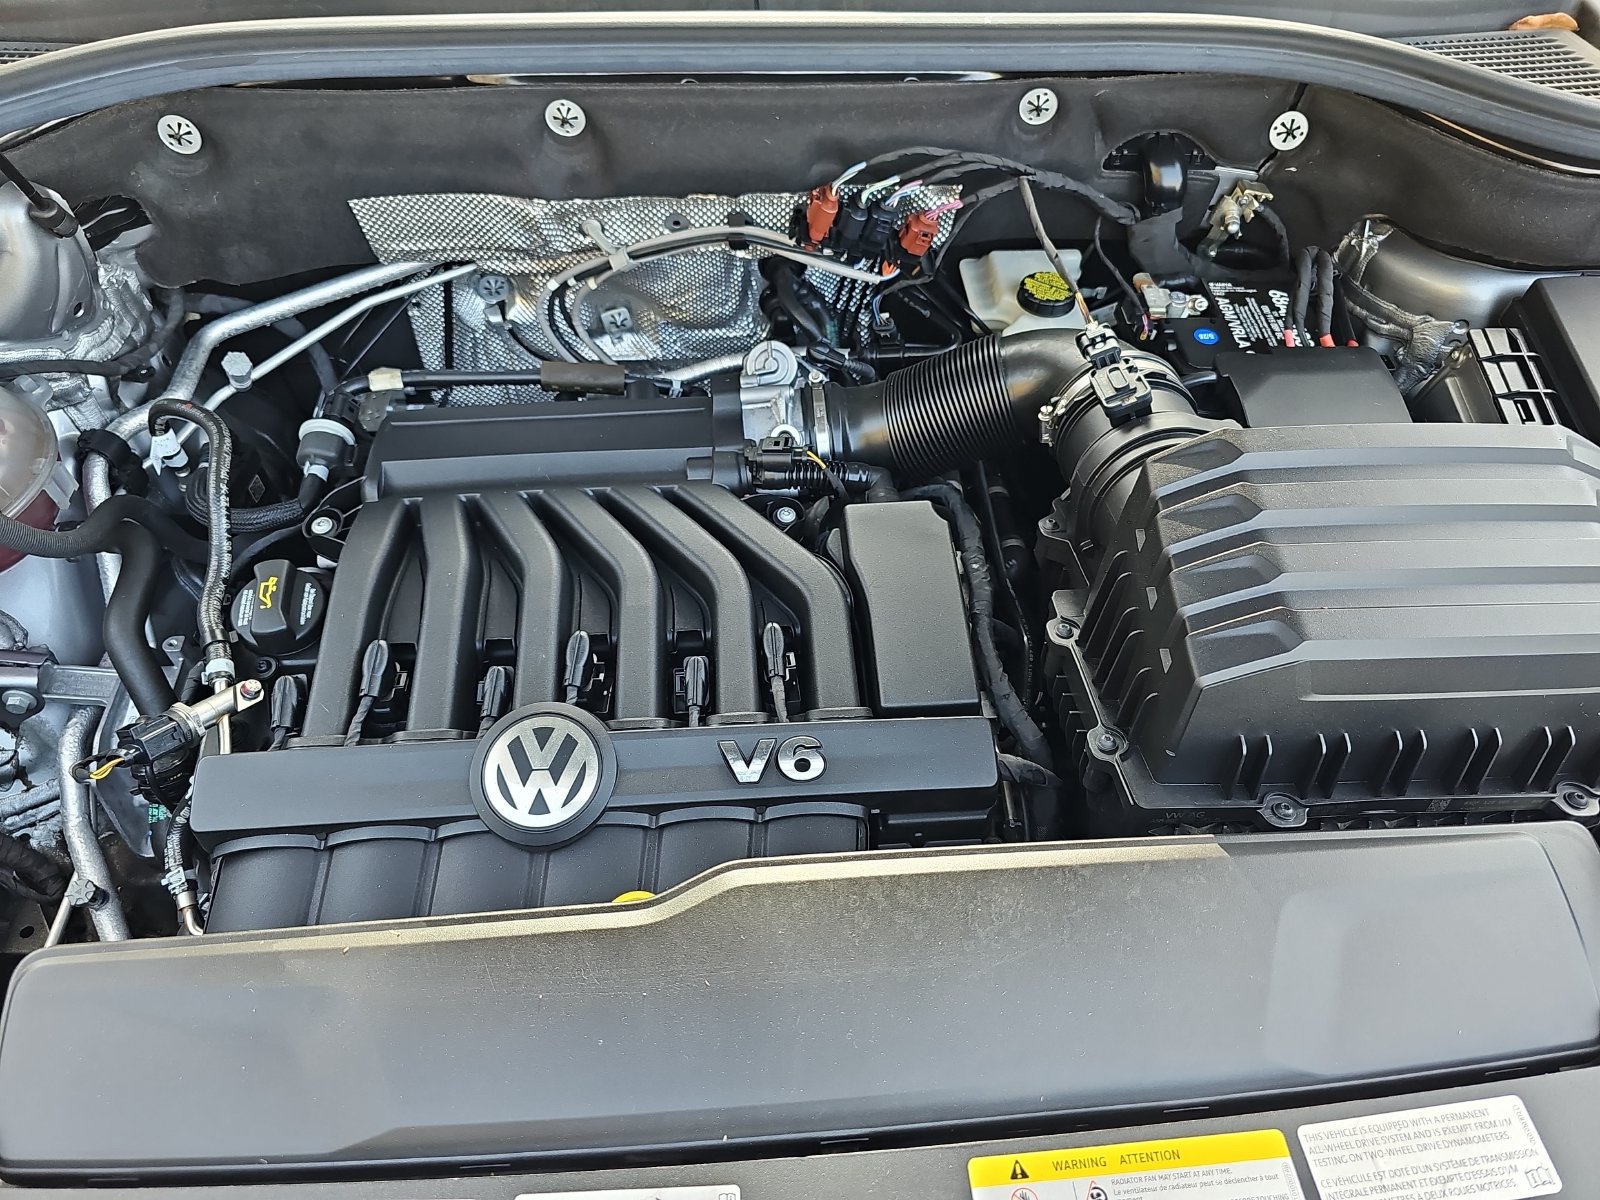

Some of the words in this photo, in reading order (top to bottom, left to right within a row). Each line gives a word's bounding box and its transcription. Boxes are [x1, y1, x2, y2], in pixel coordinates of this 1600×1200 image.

[717, 735, 827, 784] V6
[1303, 1133, 1323, 1143] THIS
[1323, 1126, 1358, 1140] VEHICLE
[1359, 1125, 1368, 1134] IS
[1368, 1119, 1409, 1134] EQUIPPED
[1409, 1115, 1432, 1127] WITH
[1433, 1116, 1441, 1124] A
[1440, 1108, 1490, 1123] PERMANENT
[1308, 1142, 1356, 1155] ALL-WHEEL
[1355, 1137, 1381, 1149] DRIVE
[1381, 1132, 1412, 1145] SYSTEM
[1413, 1129, 1432, 1140] AND
[1433, 1128, 1441, 1137] IS
[1442, 1123, 1472, 1136] EXEMPT
[1474, 1119, 1498, 1130] FROM
[1052, 1157, 1107, 1171] WARNING
[1119, 1149, 1181, 1165] ATTENTION
[1313, 1154, 1348, 1168] TESTING
[1348, 1152, 1362, 1163] ON
[1363, 1147, 1417, 1160] TWO-WHEEL
[1417, 1140, 1443, 1153] DRIVE
[1442, 1131, 1512, 1149] DYNAMOMETERS.
[1111, 1176, 1143, 1186] RADIATOR
[1144, 1175, 1157, 1183] FAN
[1158, 1173, 1172, 1181] MAY
[1173, 1171, 1192, 1180] START
[1193, 1170, 1201, 1178] AT
[1201, 1169, 1215, 1177] ANY
[1215, 1167, 1233, 1176] TIME.
[1320, 1179, 1333, 1189] CE
[1372, 1170, 1387, 1182] EST
[1410, 1164, 1433, 1176] D'UN
[1468, 1156, 1479, 1167] DE
[1479, 1148, 1539, 1165] TRANSMISSION
[1113, 1188, 1121, 1196] Le
[1123, 1185, 1158, 1195] ventilateur
[1159, 1184, 1168, 1192] de
[1168, 1182, 1198, 1191] radiateur
[1199, 1179, 1214, 1189] peut
[1264, 1173, 1279, 1181] tout
[1369, 1179, 1418, 1195] PERMANENT
[1419, 1178, 1429, 1188] ET
[1423, 1188, 1449, 1200] DEUX
[1449, 1184, 1477, 1196] ROUES
